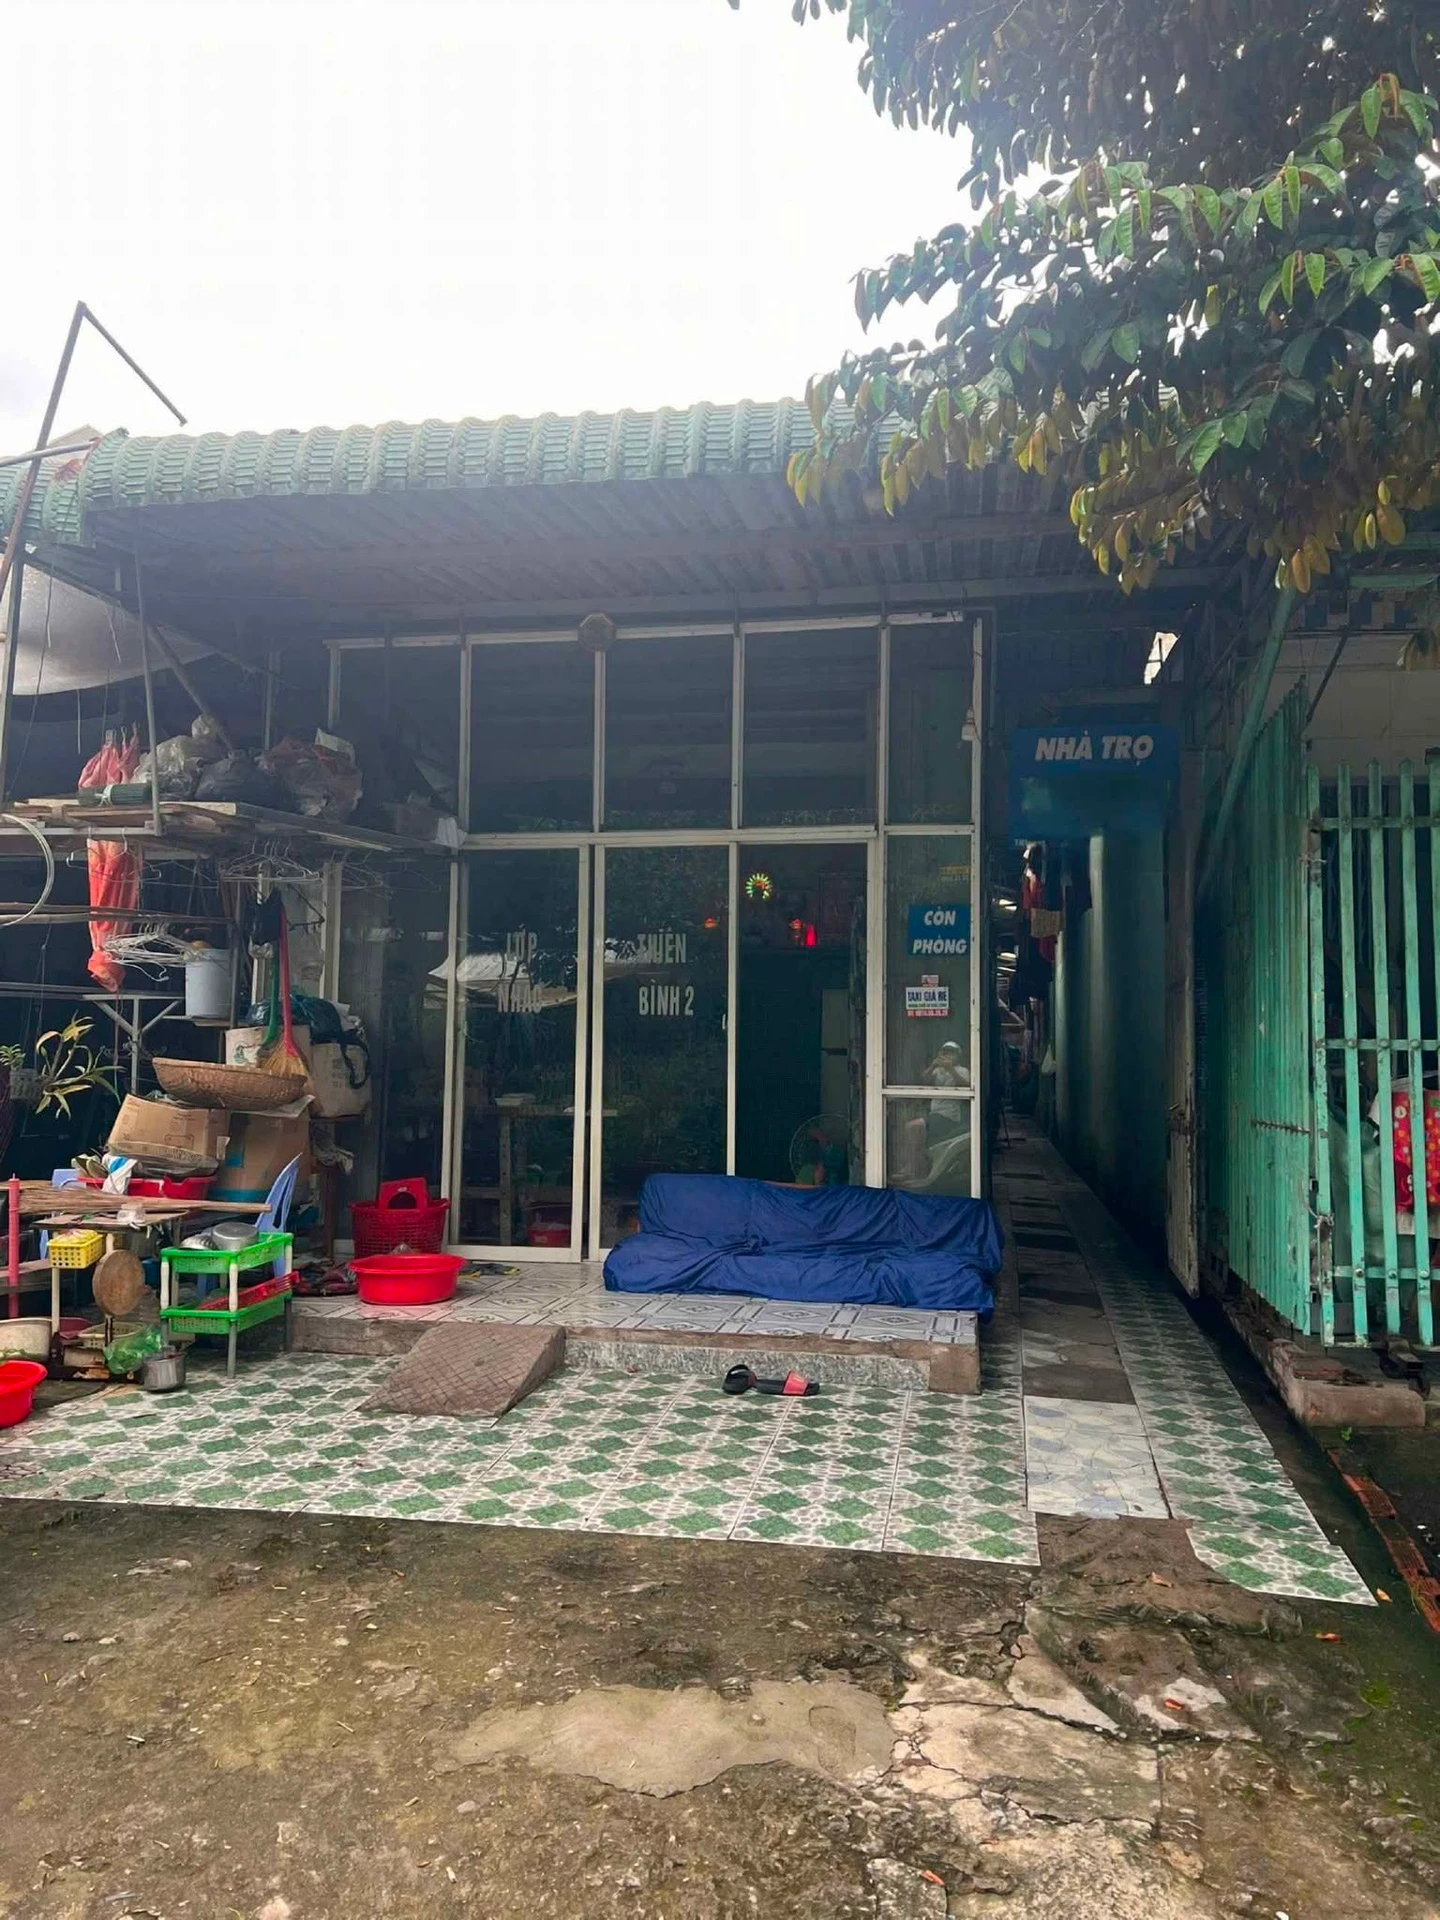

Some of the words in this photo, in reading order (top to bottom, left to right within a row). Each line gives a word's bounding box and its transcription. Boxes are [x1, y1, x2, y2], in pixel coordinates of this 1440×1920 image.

[1035, 730, 1093, 761] NHÀ
[1102, 735, 1154, 766] TRỌ
[924, 906, 956, 926] CÒN
[913, 934, 967, 954] PHÒNG
[639, 978, 680, 1016] BÌNH
[684, 986, 695, 1016] 2
